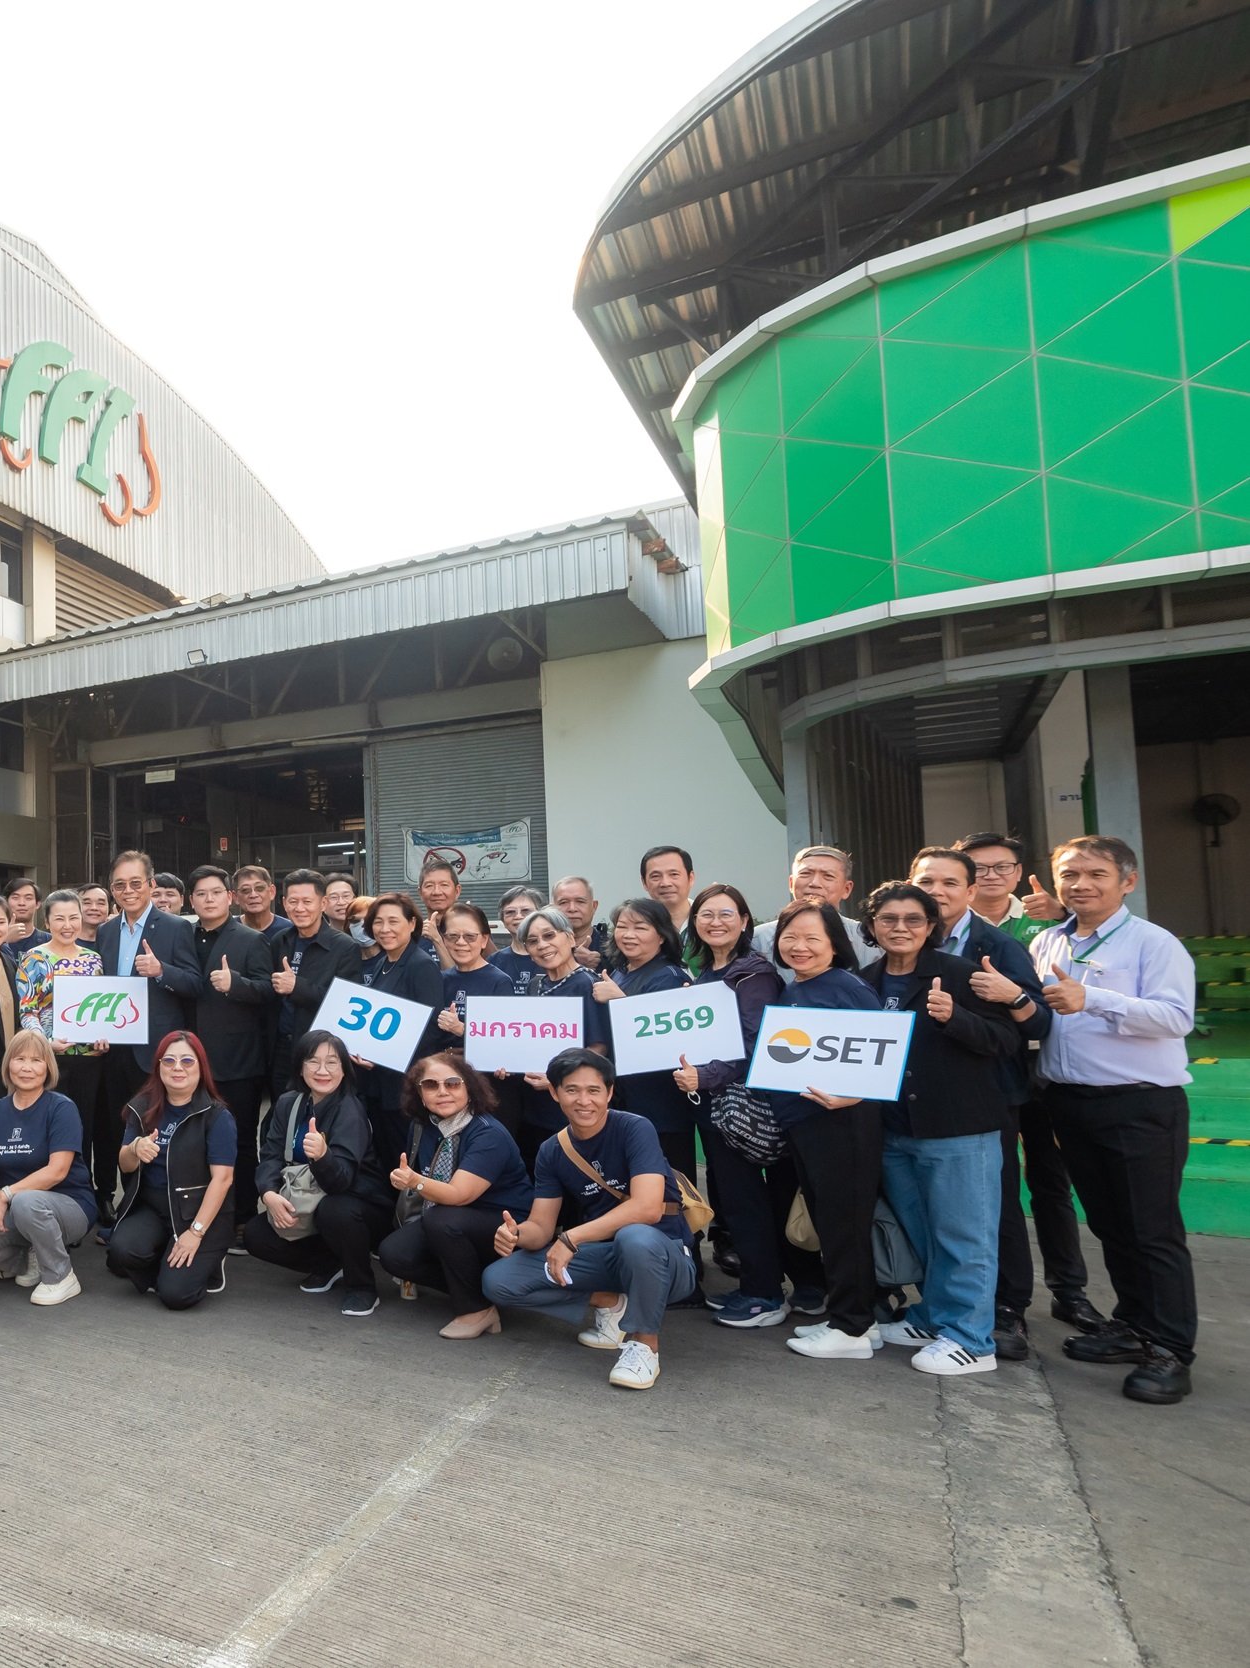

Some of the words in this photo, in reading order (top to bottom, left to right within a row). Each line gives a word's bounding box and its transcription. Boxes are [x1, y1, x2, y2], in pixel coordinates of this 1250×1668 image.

[76, 992, 129, 1022] FPI
[337, 996, 402, 1042] 30
[633, 1005, 715, 1039] 2569
[469, 1021, 578, 1039] มกราคม
[813, 1035, 898, 1066] SET
